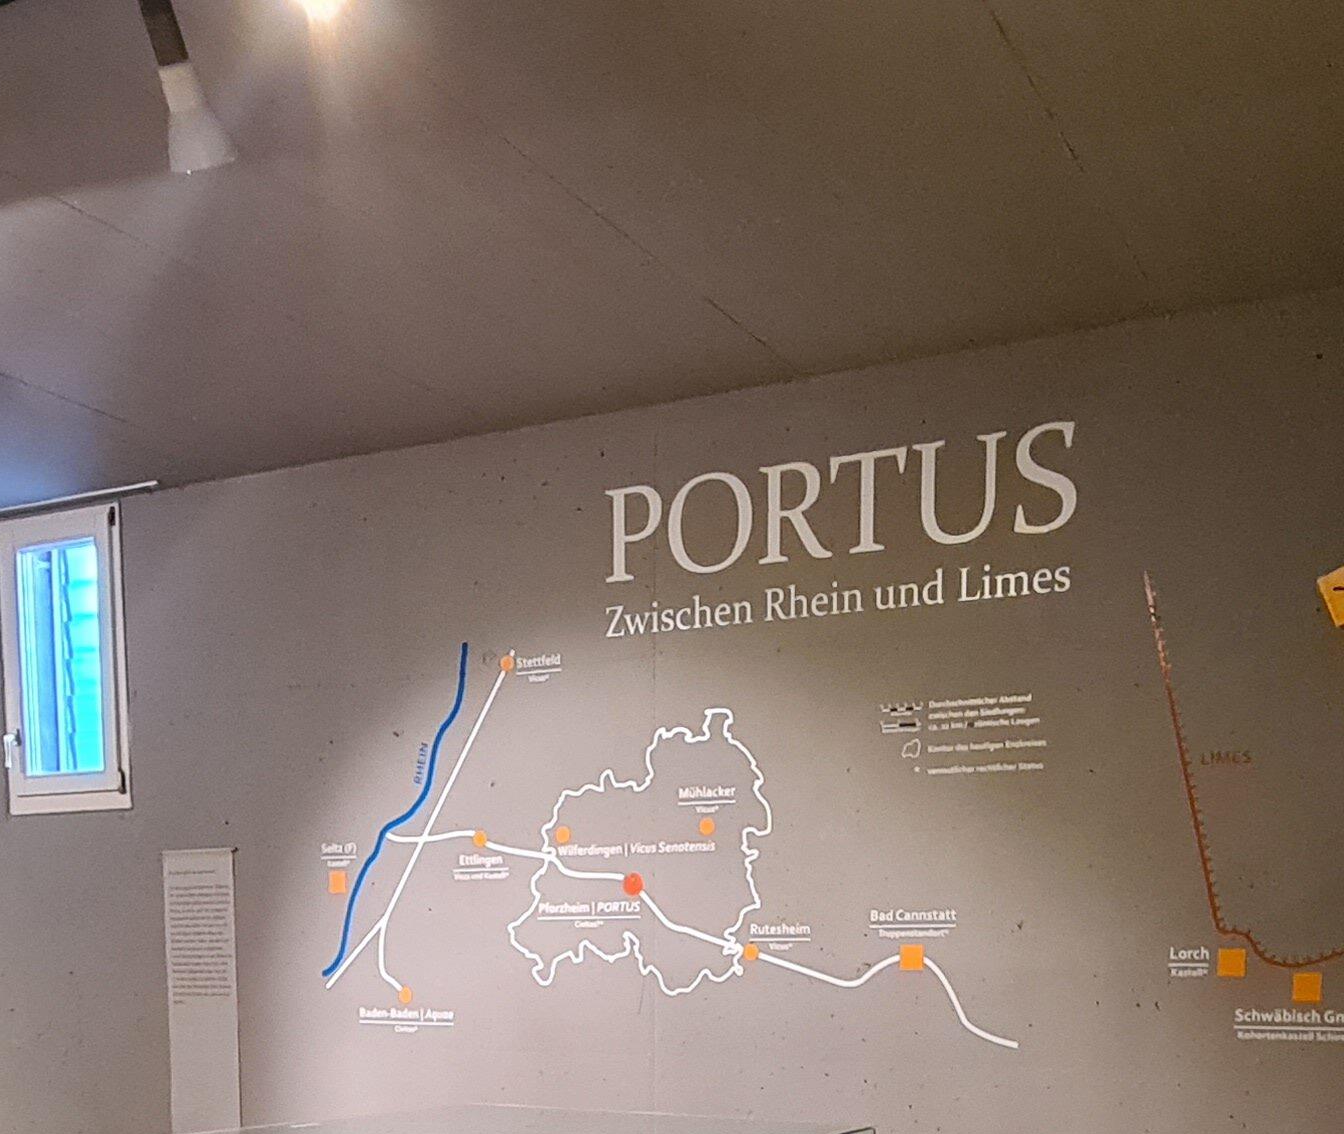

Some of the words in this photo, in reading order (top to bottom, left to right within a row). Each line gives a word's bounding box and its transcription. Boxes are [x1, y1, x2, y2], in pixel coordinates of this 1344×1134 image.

[604, 420, 1078, 585] PORTUS
[604, 596, 754, 639] Zwischen
[763, 580, 865, 623] Rhein
[874, 568, 945, 611] und
[957, 563, 1072, 602] Limes
[413, 742, 429, 786] RHEIN
[1200, 751, 1253, 766] LIMES
[678, 786, 736, 799] Mühlacker
[597, 900, 641, 913] PORTUS
[869, 909, 894, 922] Bad
[895, 908, 957, 921] Cannstatt
[750, 923, 812, 935] Rutesheim
[1168, 945, 1210, 961] Lorch
[1233, 1007, 1322, 1024] Schwäbisch
